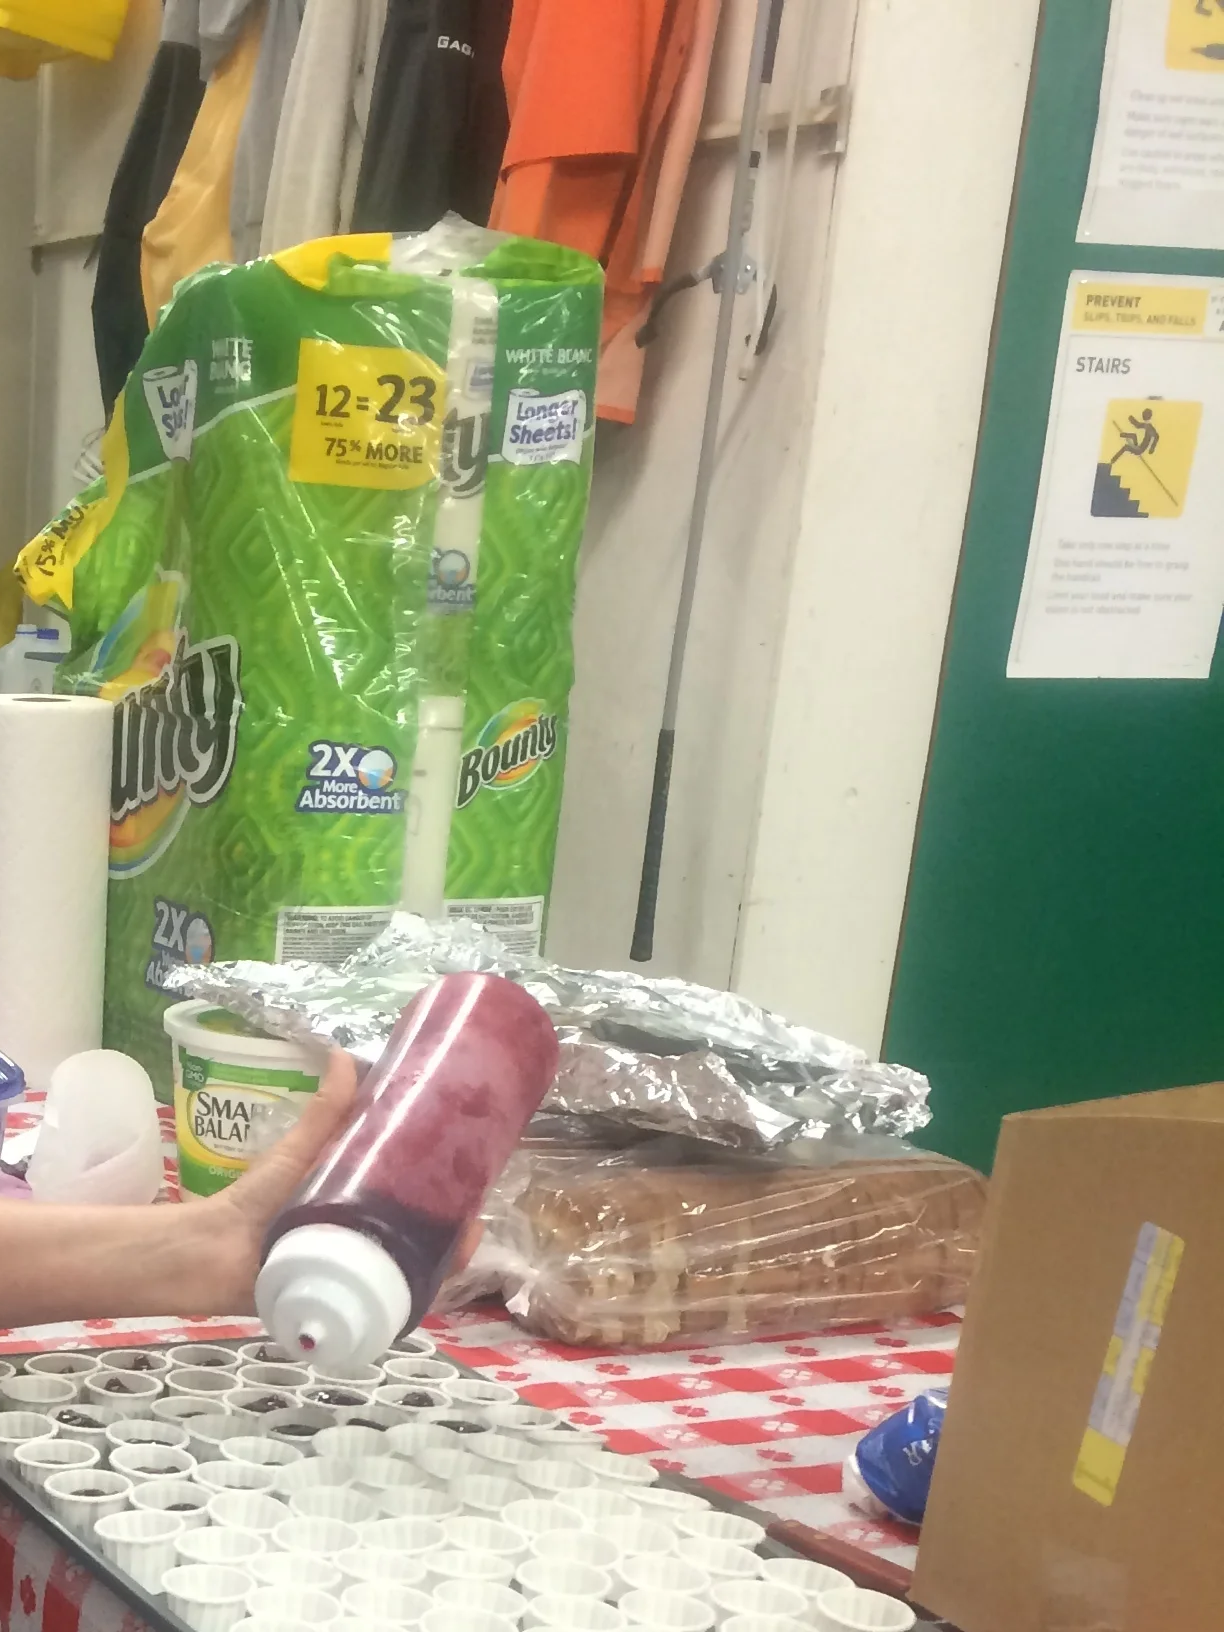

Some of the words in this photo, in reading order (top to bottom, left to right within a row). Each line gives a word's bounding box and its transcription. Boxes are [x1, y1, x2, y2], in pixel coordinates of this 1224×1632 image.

[437, 35, 475, 58] GAG
[1086, 294, 1142, 308] PREVENT
[506, 348, 553, 363] WHITE
[1076, 357, 1132, 375] STAIRS
[517, 400, 579, 424] Longer
[509, 417, 578, 445] Sheets!
[325, 437, 362, 458] 75%
[365, 442, 424, 464] MORE
[110, 634, 241, 815] unty
[309, 743, 359, 778] 2X
[457, 712, 558, 808] Bounty
[298, 788, 402, 810] Absorbent
[322, 780, 359, 793] More
[153, 901, 187, 953] 2X
[196, 1091, 257, 1123] SMA
[194, 1115, 251, 1143] BALA
